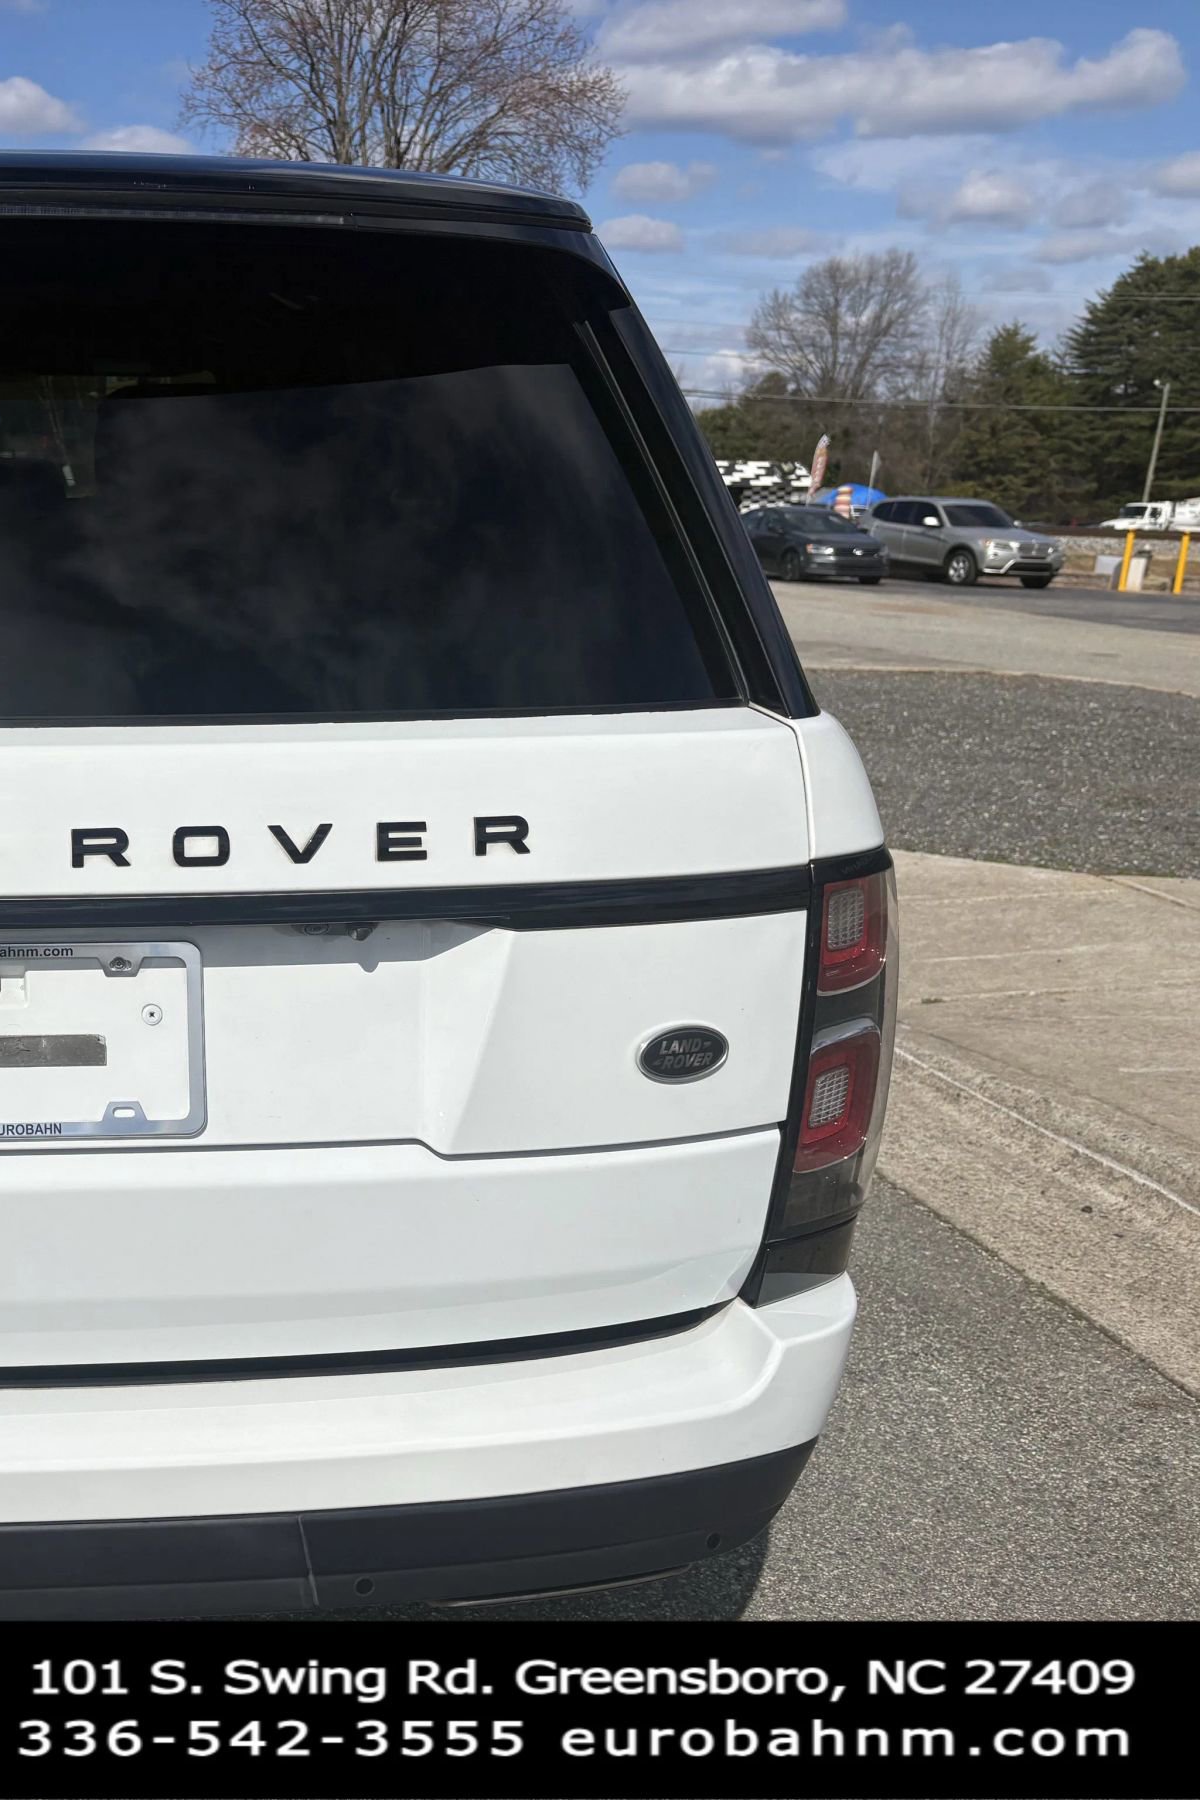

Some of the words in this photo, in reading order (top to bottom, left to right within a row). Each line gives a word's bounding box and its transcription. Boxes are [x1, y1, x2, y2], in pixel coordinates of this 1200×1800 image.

[71, 815, 532, 868] ROVER
[660, 1038, 702, 1054] LAND
[661, 1052, 714, 1069] ROVER
